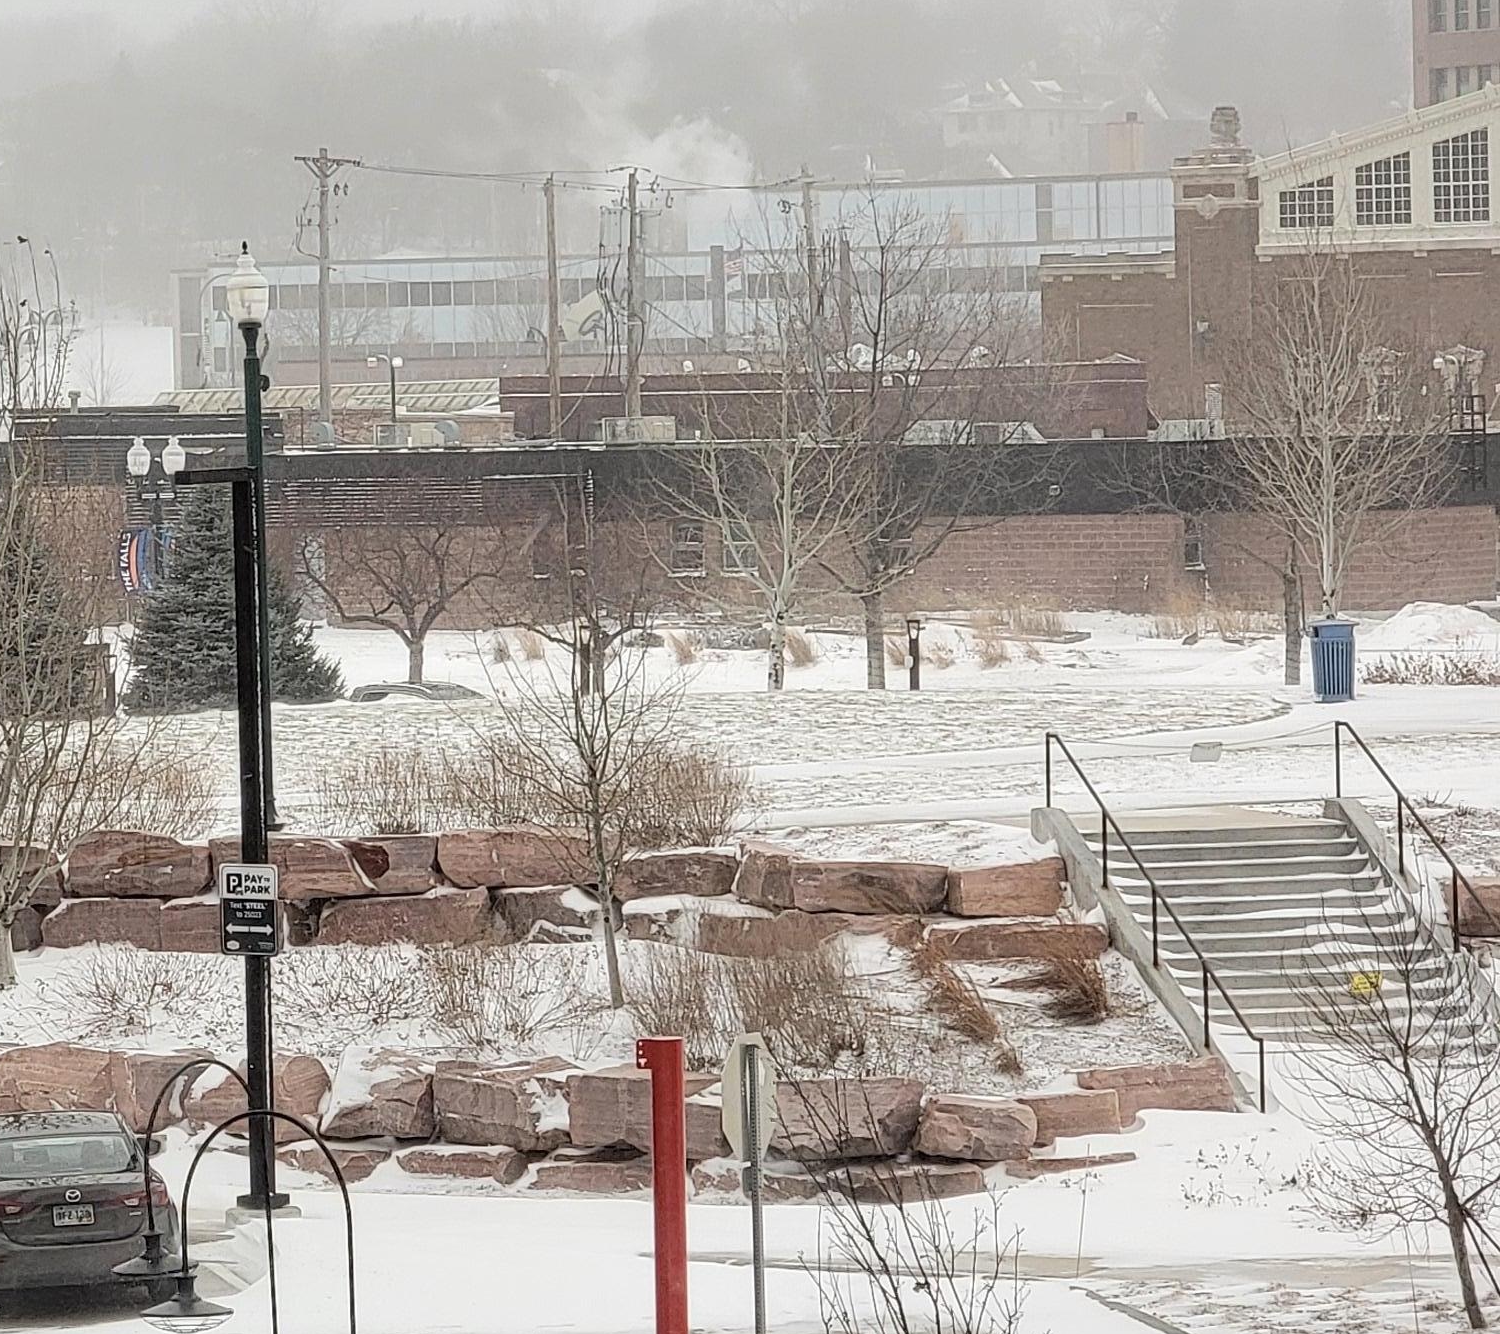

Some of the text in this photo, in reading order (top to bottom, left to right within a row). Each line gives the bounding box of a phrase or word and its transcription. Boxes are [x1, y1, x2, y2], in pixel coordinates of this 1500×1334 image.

[119, 532, 132, 567] FALLS
[244, 874, 263, 884] PAY
[244, 885, 271, 895] PARK
